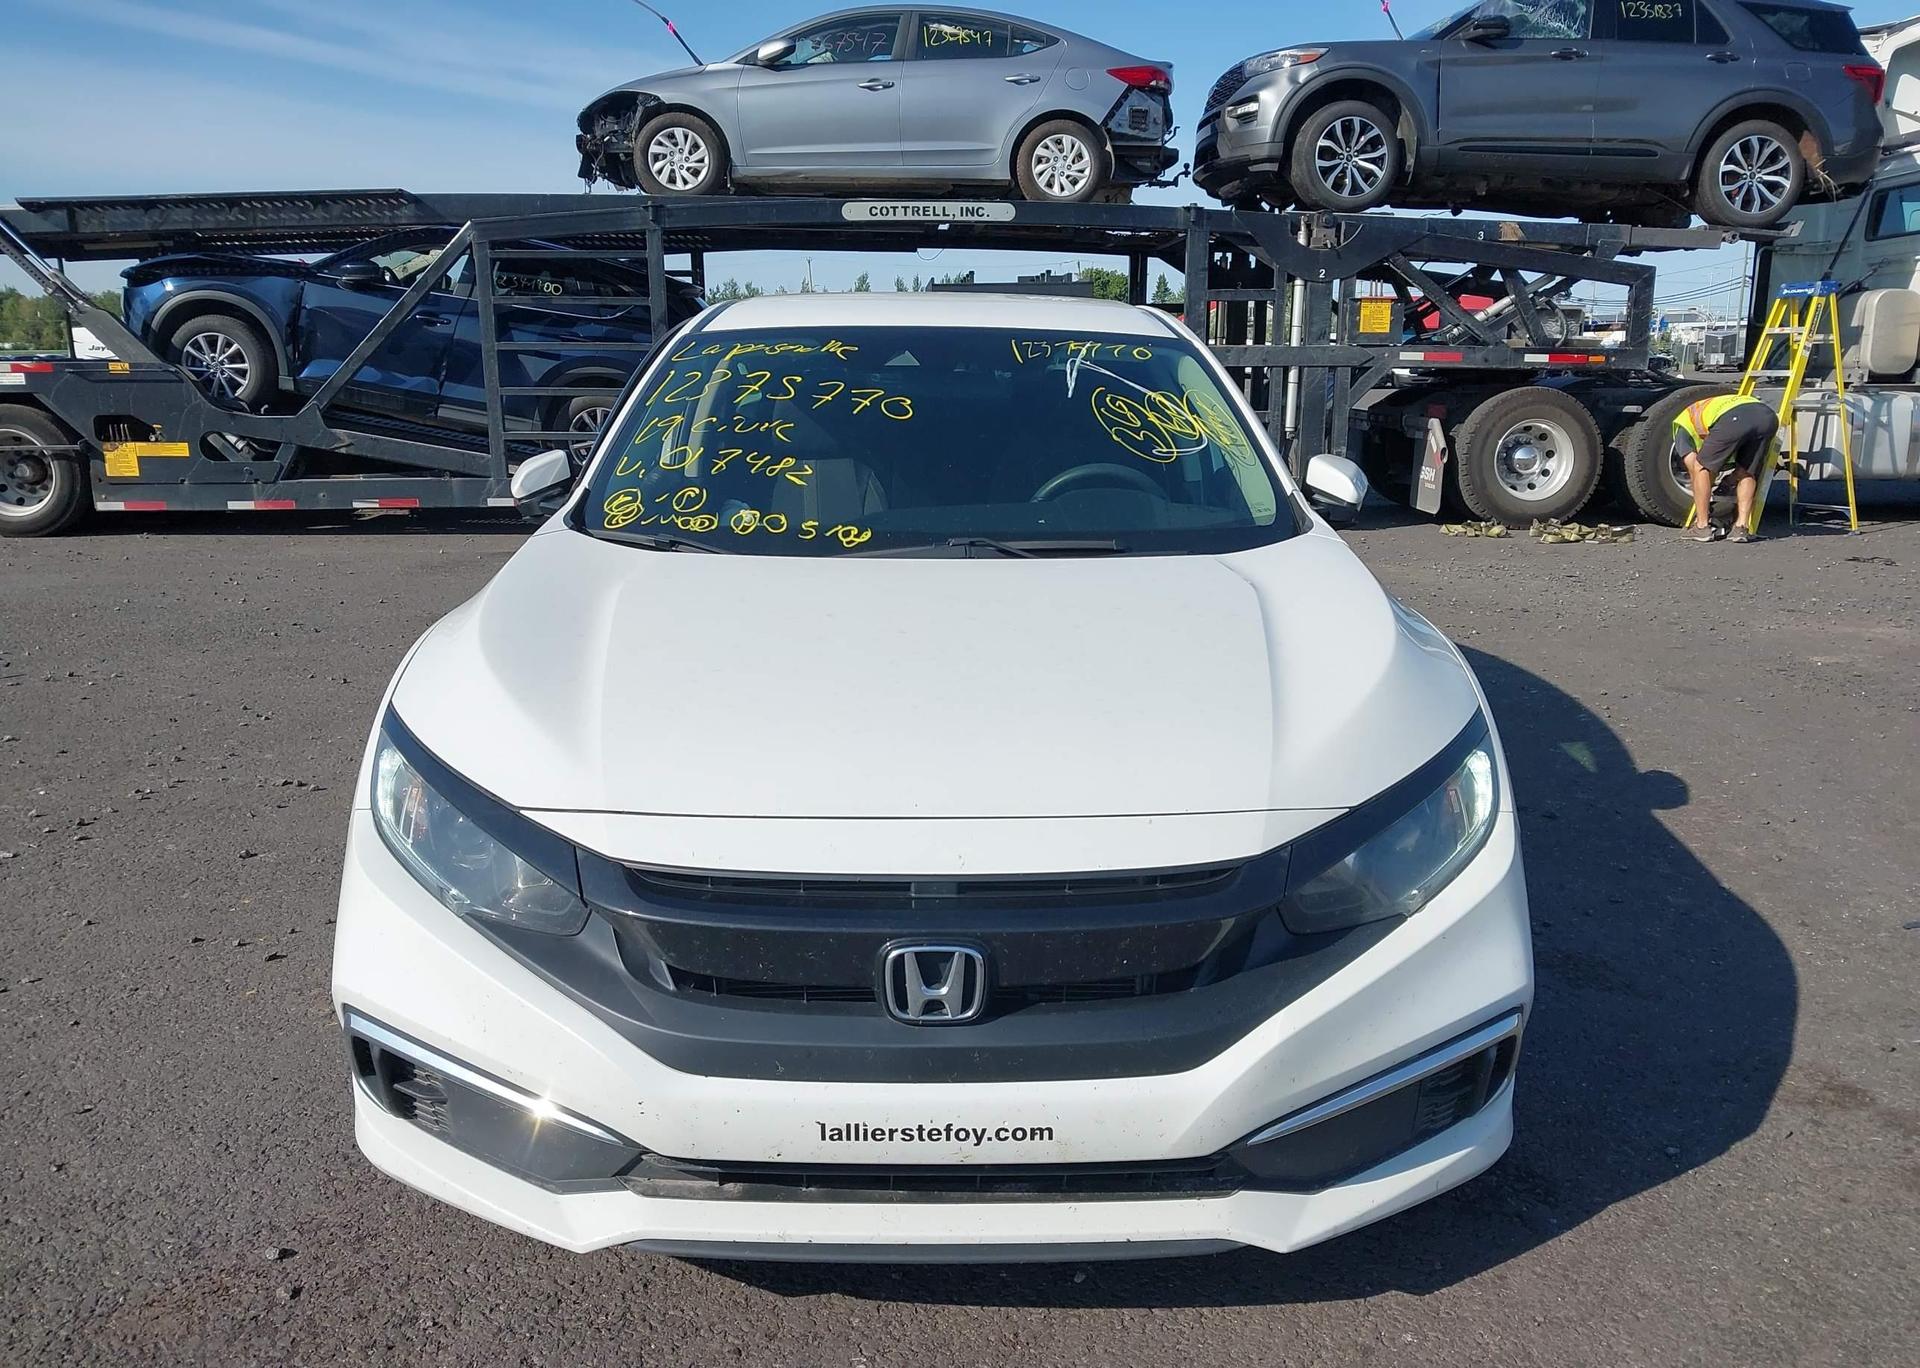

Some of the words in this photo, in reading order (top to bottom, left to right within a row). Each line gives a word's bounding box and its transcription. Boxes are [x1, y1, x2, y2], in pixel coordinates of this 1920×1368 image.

[868, 205, 956, 220] COTTRELL,
[960, 206, 990, 218] INC.
[1477, 230, 1485, 240] 3
[1318, 268, 1326, 279] 2
[817, 1121, 1054, 1147] lallierstefoy.com
